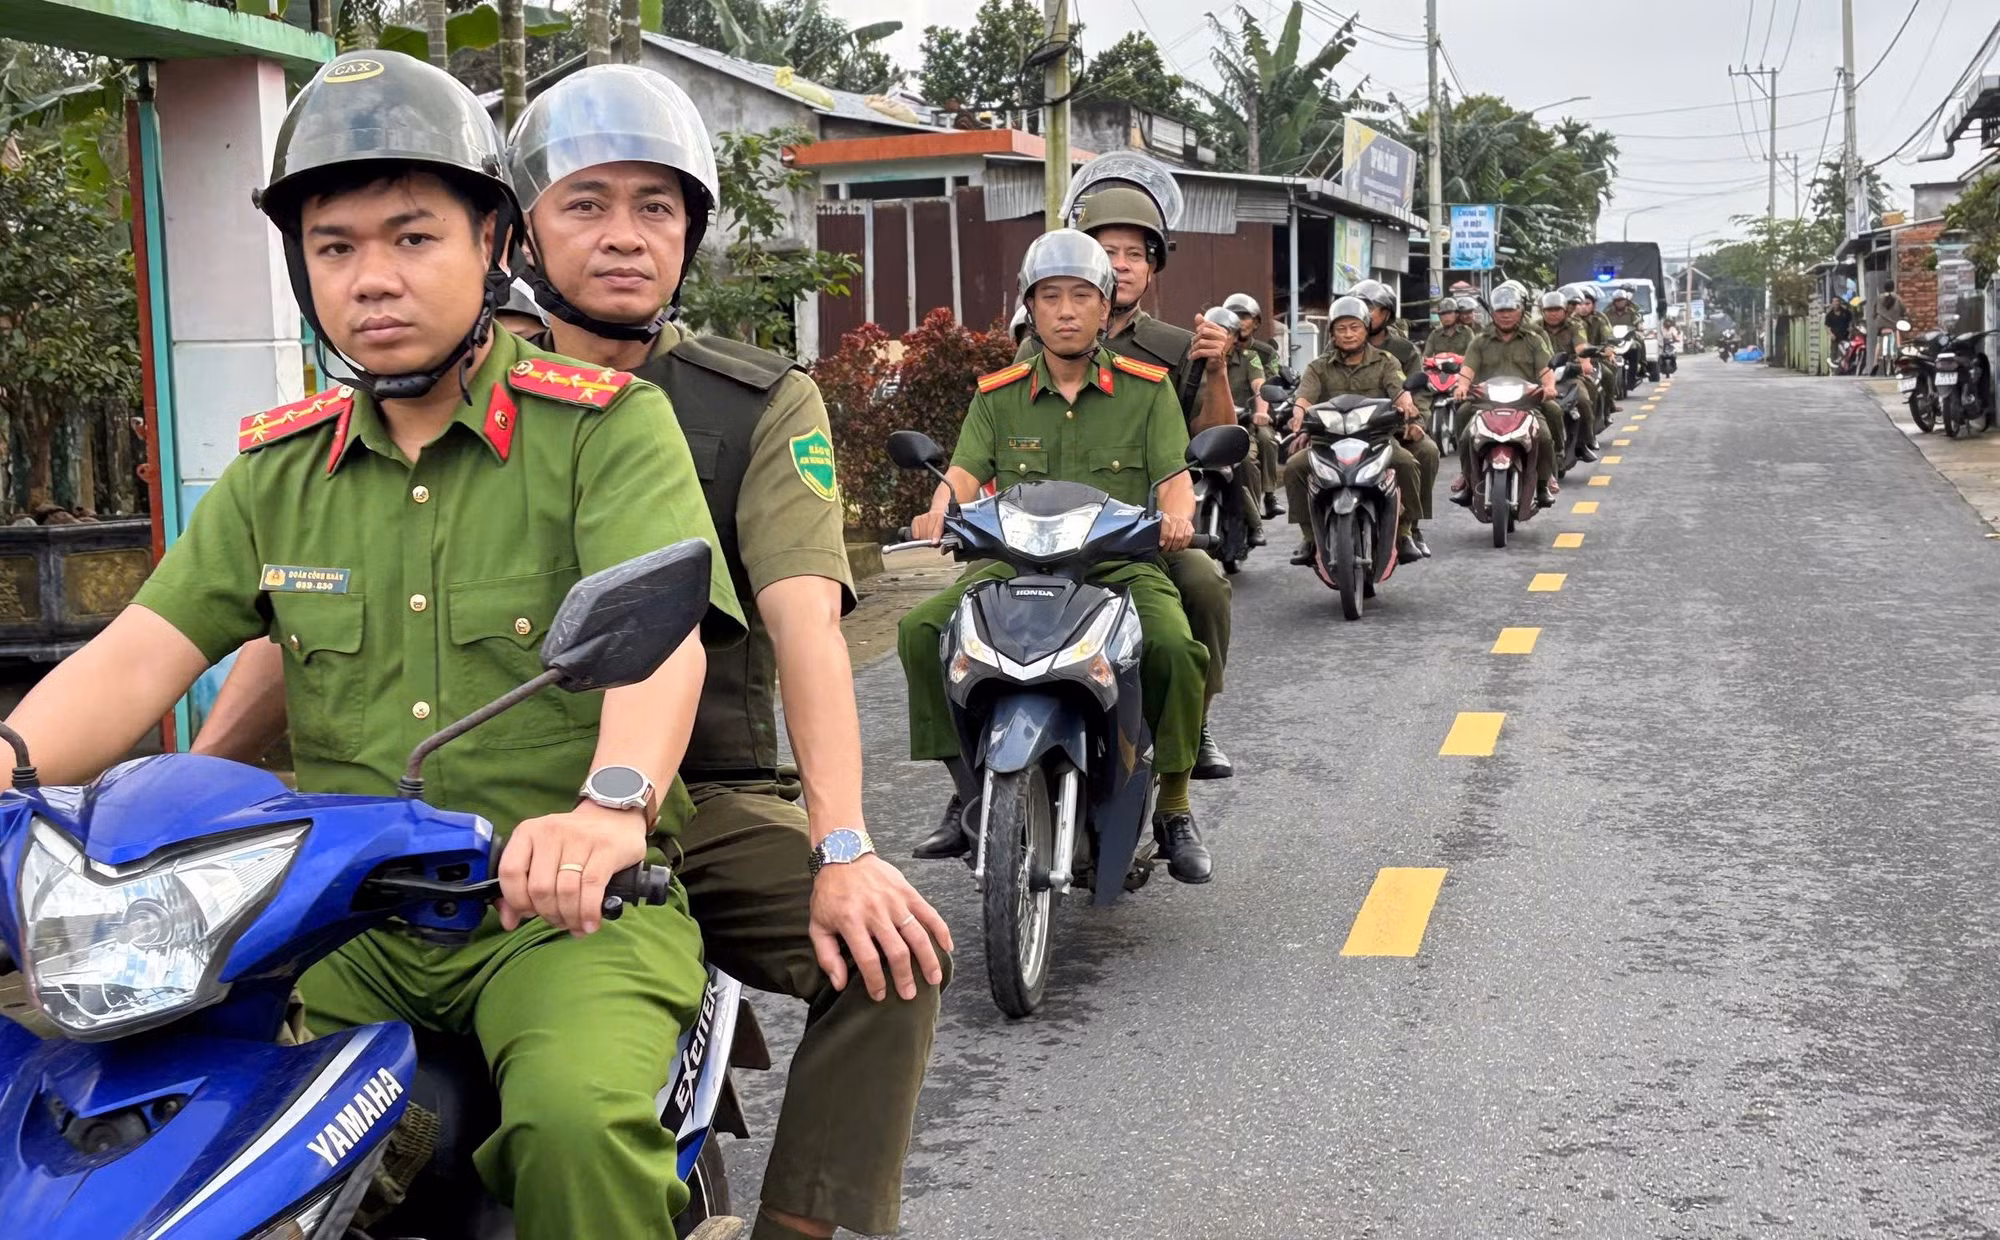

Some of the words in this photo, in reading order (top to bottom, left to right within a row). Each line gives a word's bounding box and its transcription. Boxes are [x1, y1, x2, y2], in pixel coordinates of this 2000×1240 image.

[334, 62, 371, 76] CAX
[1015, 589, 1055, 598] HONDA
[306, 1067, 404, 1168] YAMAHA
